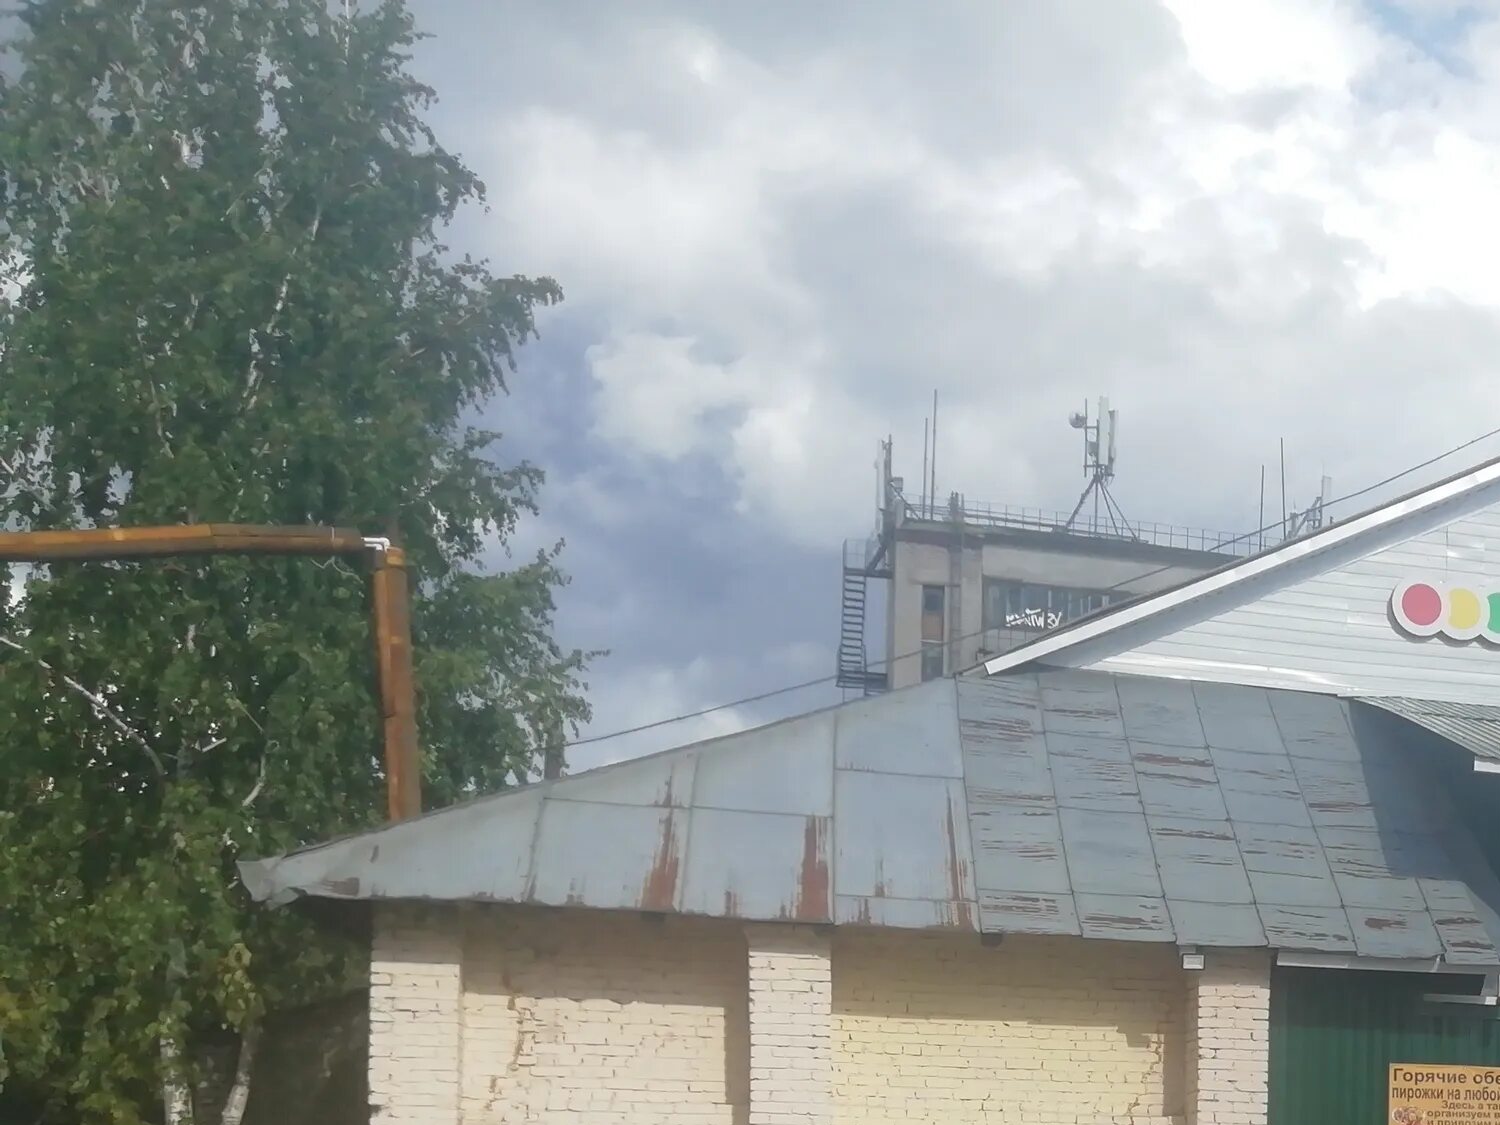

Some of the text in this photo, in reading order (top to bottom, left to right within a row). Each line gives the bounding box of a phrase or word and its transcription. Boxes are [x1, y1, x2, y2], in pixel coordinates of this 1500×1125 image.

[1393, 1068, 1467, 1086] Горячие
[1392, 1086, 1444, 1102] пирожки
[1448, 1089, 1461, 1100] на
[1441, 1100, 1475, 1111] Здесь
[1427, 1110, 1491, 1120] организуем
